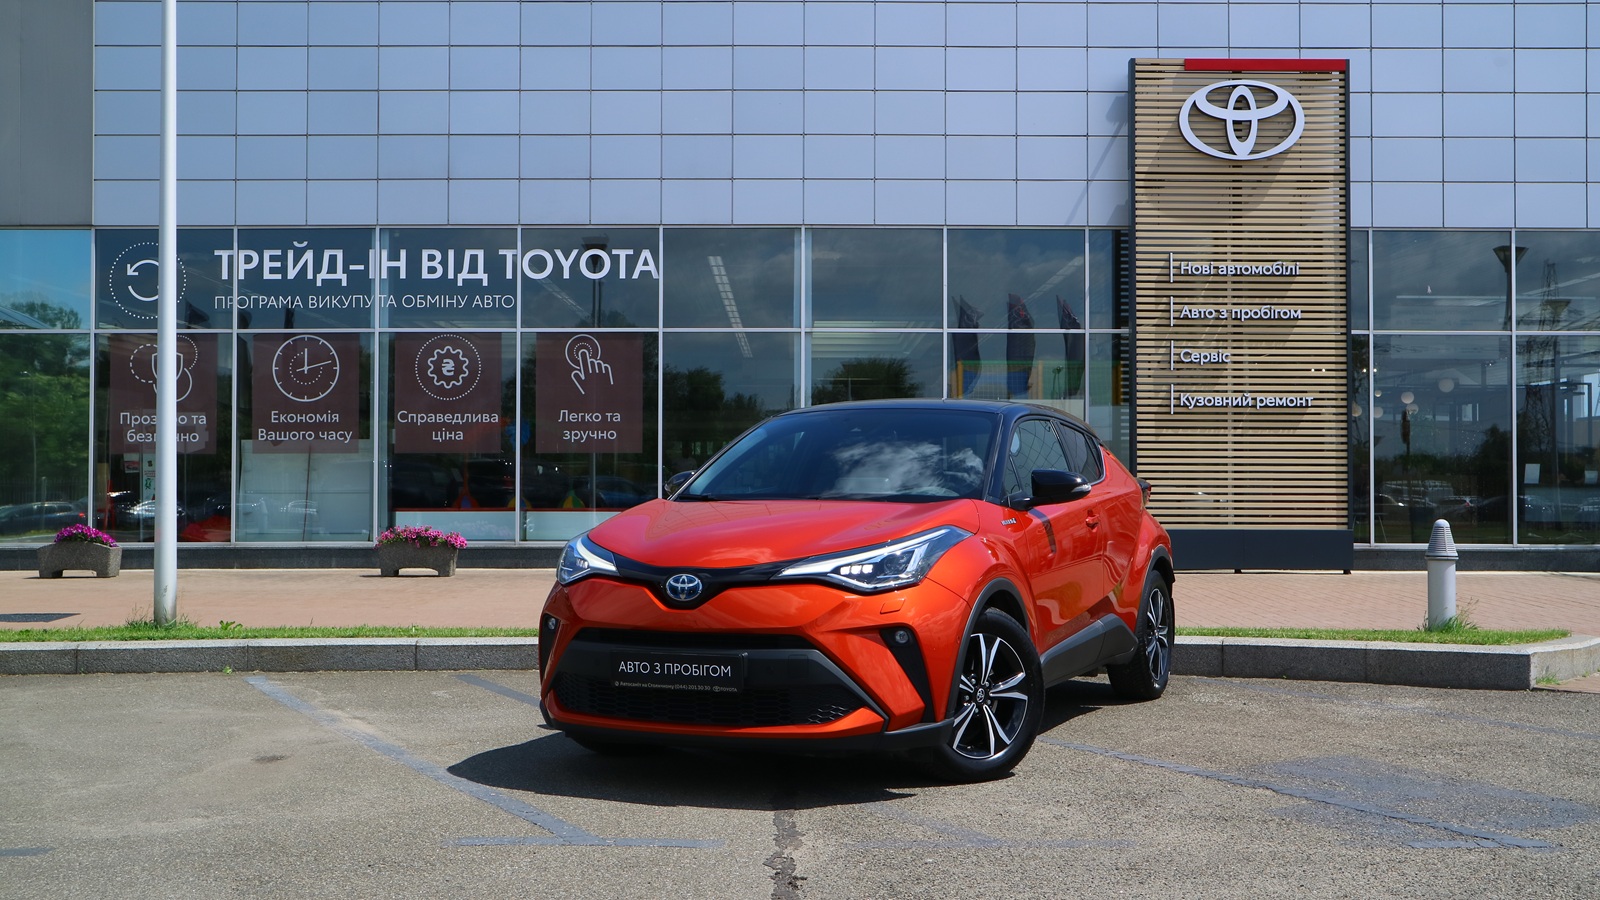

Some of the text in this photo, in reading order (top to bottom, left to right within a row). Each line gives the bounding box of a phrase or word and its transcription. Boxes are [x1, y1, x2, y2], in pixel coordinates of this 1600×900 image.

[214, 241, 660, 286] ТРЕЙД-ІН ВІД TOYOTA
[1180, 261, 1300, 275] Нові автомобілі
[214, 294, 515, 309] ПРОГРАМА ВИКУПУ ТА ОБМІНУ АВТО
[1180, 305, 1302, 322] Авто з пробігом
[1180, 349, 1231, 366] Сервіс
[1180, 393, 1314, 410] Кузовний ремонт
[120, 412, 207, 428] Прозо та
[271, 410, 339, 423] Економія
[397, 410, 499, 426] Справедлива
[558, 410, 621, 422] Легко та
[127, 429, 199, 442] безно
[258, 428, 353, 443] Вашого часу
[432, 427, 464, 442] ціна
[563, 430, 617, 443] зручно
[618, 660, 651, 674] АВТО
[664, 662, 732, 677] ПРОБІГОМ
